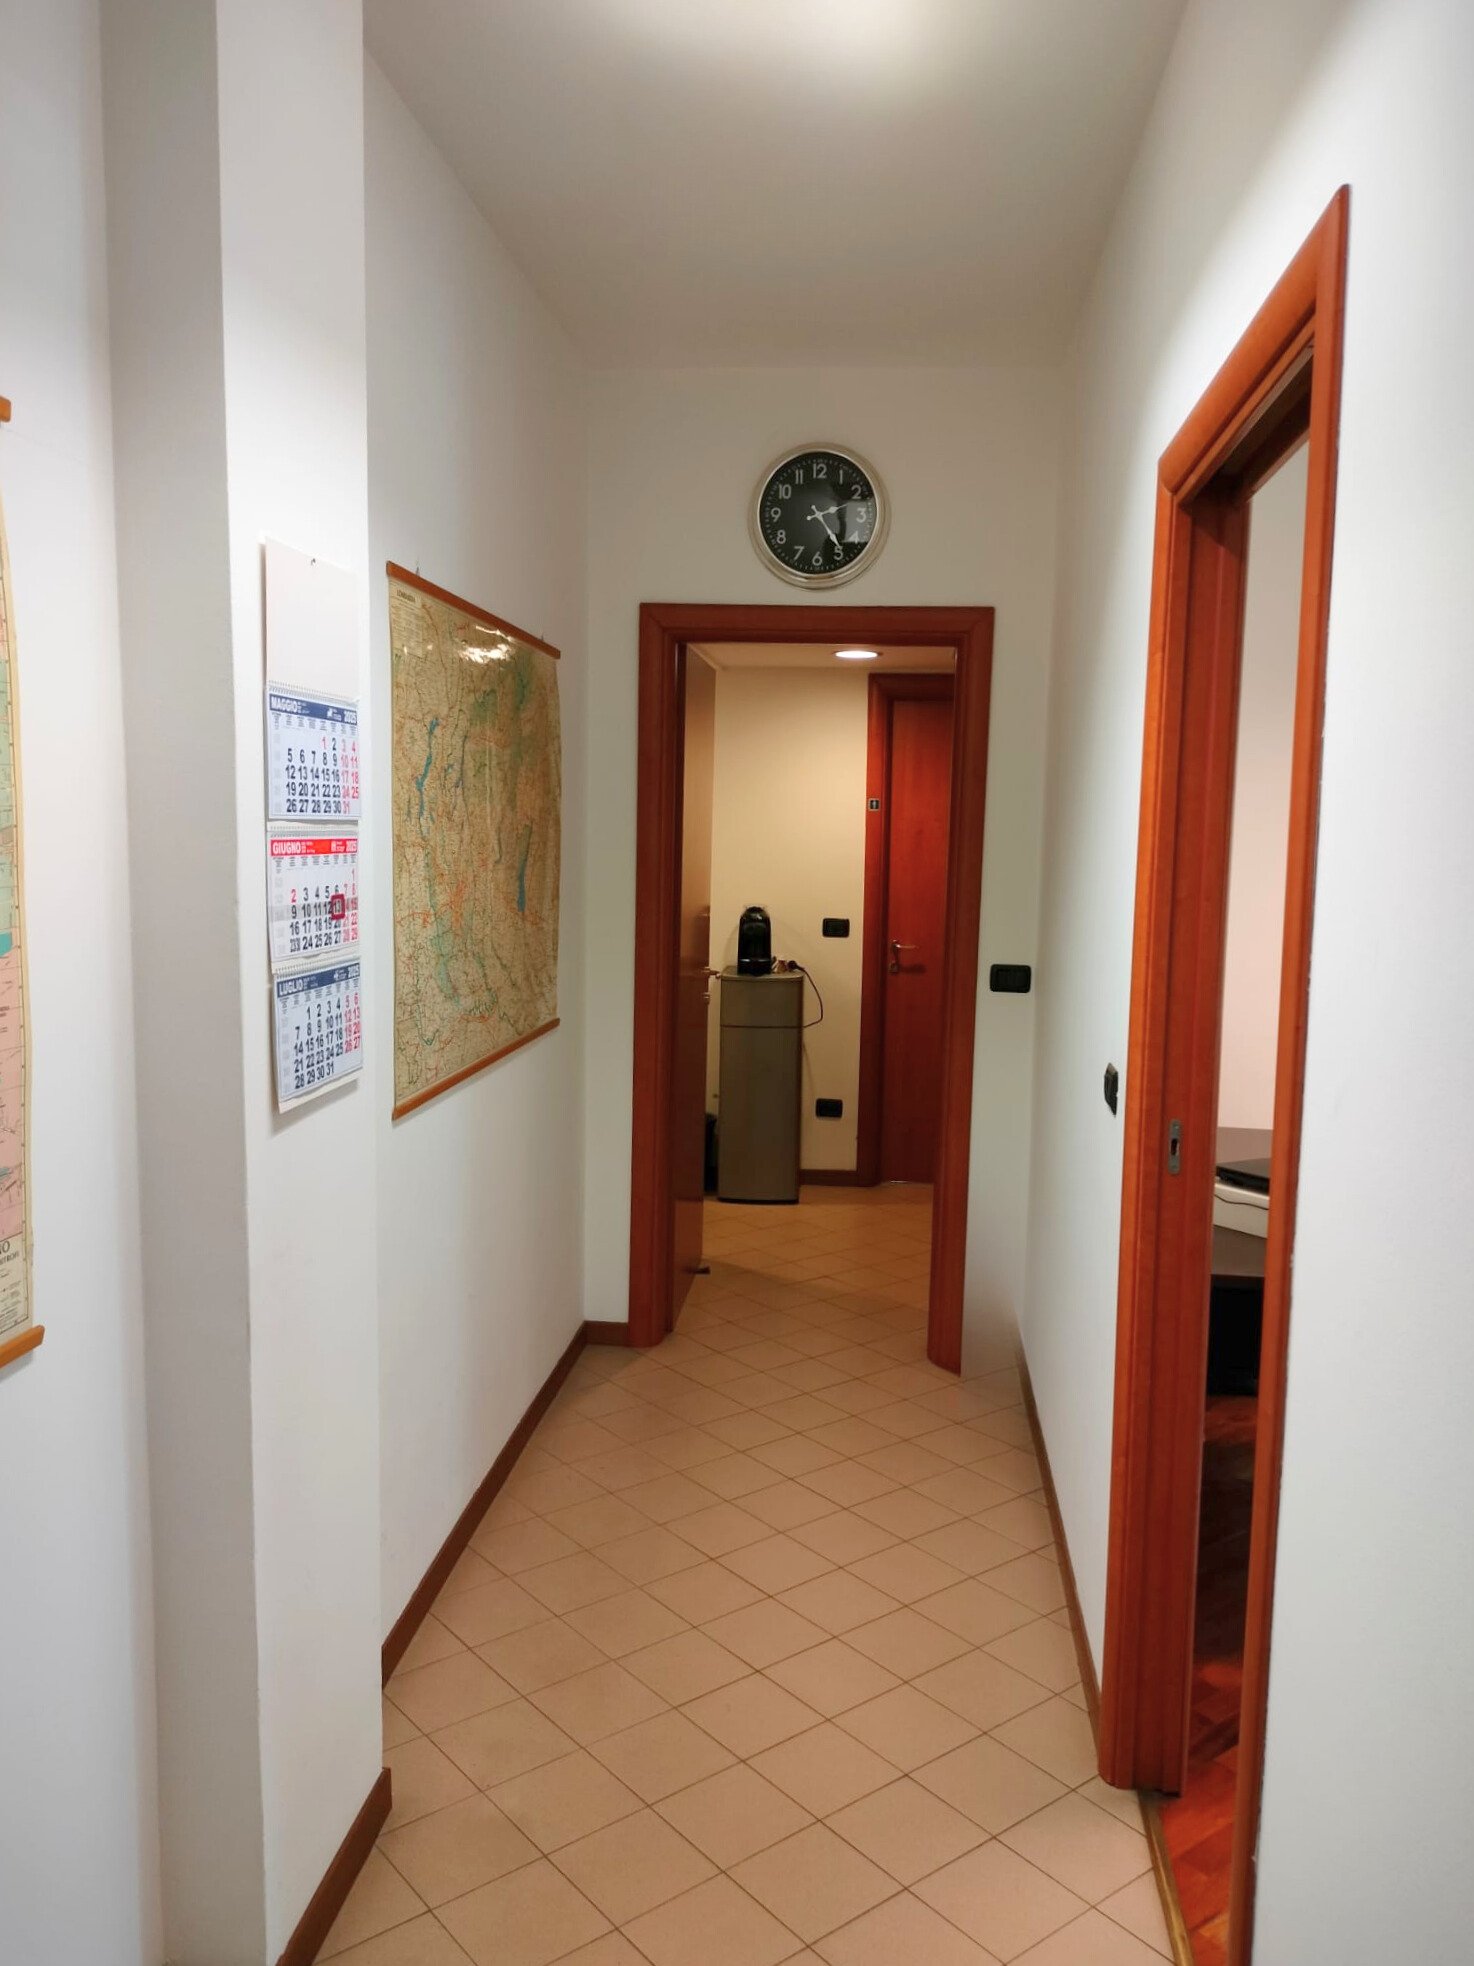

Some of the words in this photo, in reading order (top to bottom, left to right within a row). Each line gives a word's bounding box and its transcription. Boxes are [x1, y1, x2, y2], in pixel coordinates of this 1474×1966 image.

[796, 470, 803, 484] 11
[839, 470, 843, 484] 1
[813, 464, 827, 478] 12
[779, 484, 791, 499] 10
[851, 485, 862, 499] 2
[771, 508, 781, 522] 9
[856, 508, 866, 522] 3
[777, 530, 786, 544] 8
[850, 531, 859, 544] 4
[794, 546, 804, 560] 7
[834, 546, 843, 560] 5
[812, 552, 822, 566] 6
[271, 696, 297, 712] MAGGIO
[322, 736, 327, 749] 1
[332, 738, 336, 750] 2
[352, 742, 356, 752] 4
[288, 748, 292, 762] 5
[300, 750, 305, 763] 6
[312, 751, 316, 764] 7
[323, 752, 327, 766] 8
[333, 754, 337, 766] 9
[341, 755, 348, 768] 10
[351, 756, 358, 768] 11
[286, 765, 296, 779] 12
[298, 766, 307, 780] 13
[310, 768, 319, 780] 14
[322, 769, 330, 782] 15
[332, 770, 340, 782] 16
[342, 771, 348, 782] 17
[352, 772, 358, 783] 18
[286, 782, 296, 796] 19
[298, 782, 308, 796] 20
[311, 783, 320, 796] 21
[322, 784, 331, 798] 22
[332, 784, 340, 798] 23
[352, 786, 358, 798] 25
[286, 799, 296, 812] 26
[299, 799, 308, 812] 27
[312, 800, 320, 813] 28
[324, 800, 331, 813] 29
[333, 800, 341, 813] 30
[342, 801, 350, 814] 31
[272, 842, 300, 854] GIUGNO
[292, 889, 296, 903] 2
[304, 888, 308, 901] 3
[315, 886, 319, 899] 4
[326, 886, 330, 898] 5
[292, 905, 296, 918] 9
[302, 904, 311, 917] 10
[314, 903, 322, 916] 11
[324, 902, 332, 914] 12
[290, 922, 300, 936] 16
[302, 920, 311, 933] 17
[315, 918, 322, 932] 18
[324, 916, 332, 930] 19
[302, 936, 312, 950] 24
[315, 935, 322, 948] 25
[324, 933, 332, 946] 26
[334, 931, 341, 944] 27
[307, 1006, 310, 1020] 1
[317, 1004, 322, 1017] 2
[327, 1001, 331, 1014] 3
[336, 998, 340, 1010] 4
[295, 1026, 300, 1040] 7
[307, 1022, 312, 1036] 8
[317, 1020, 322, 1032] 9
[326, 1015, 333, 1028] 10
[336, 1012, 342, 1026] 11
[345, 1010, 352, 1023] 12
[294, 1042, 303, 1056] 14
[306, 1038, 314, 1052] 15
[316, 1034, 324, 1048] 16
[326, 1030, 334, 1044] 17
[336, 1028, 342, 1040] 18
[294, 1058, 304, 1073] 21
[306, 1054, 314, 1069] 22
[316, 1050, 324, 1064] 23
[326, 1046, 334, 1060] 24
[336, 1042, 343, 1056] 25
[345, 1040, 352, 1053] 26
[295, 1074, 304, 1089] 28
[307, 1070, 315, 1084] 29
[317, 1066, 324, 1080] 30
[326, 1062, 334, 1076] 31
